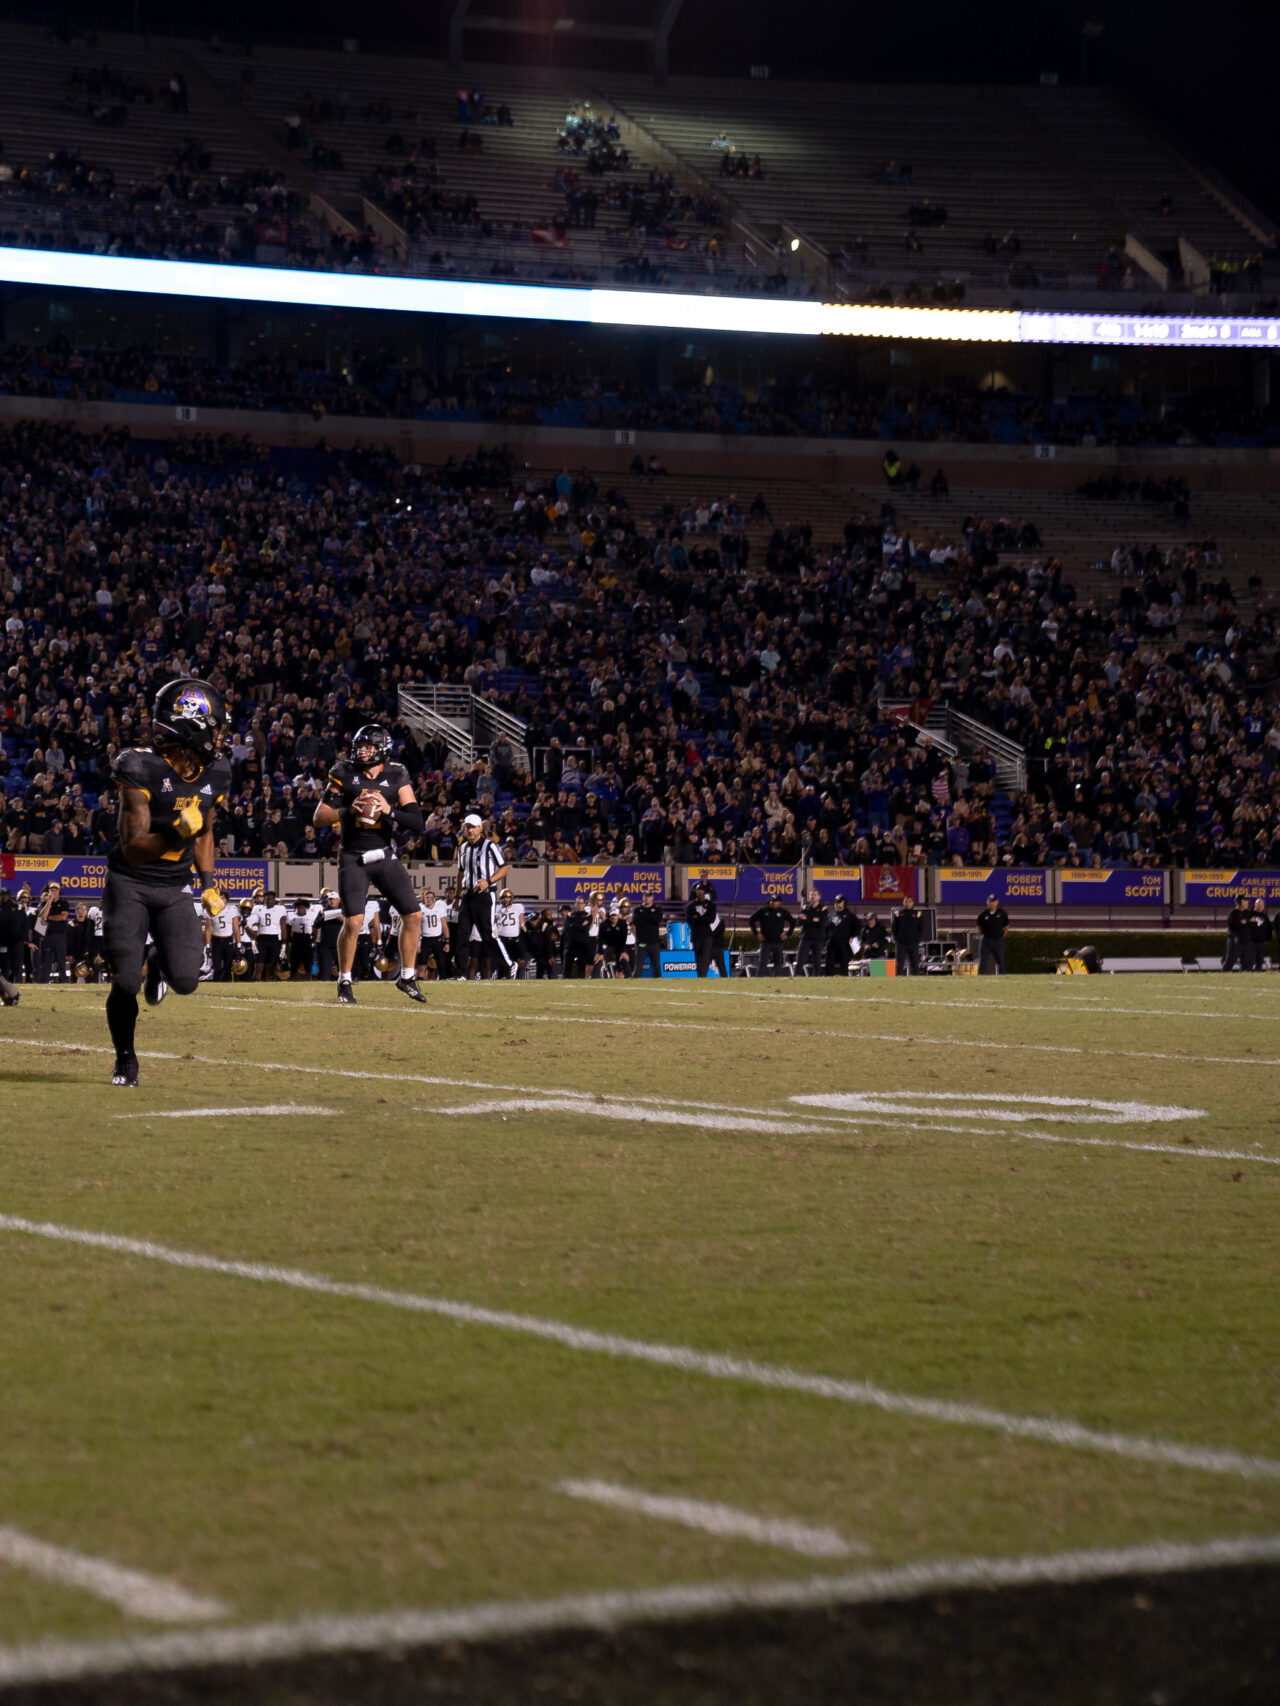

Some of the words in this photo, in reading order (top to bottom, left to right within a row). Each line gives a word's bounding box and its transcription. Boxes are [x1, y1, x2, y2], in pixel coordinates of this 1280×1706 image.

[633, 872, 662, 881] BOWL
[764, 873, 794, 882] TERRY
[1006, 875, 1043, 884] ROBERT
[1142, 876, 1161, 885] TOM
[574, 882, 662, 894] APPEARANCES
[761, 884, 794, 895] LONG
[1005, 885, 1043, 896] JONES
[1125, 886, 1161, 897] SCOTT
[1206, 887, 1266, 898] CRUMPLER
[425, 914, 438, 929] 10
[501, 913, 516, 927] 25
